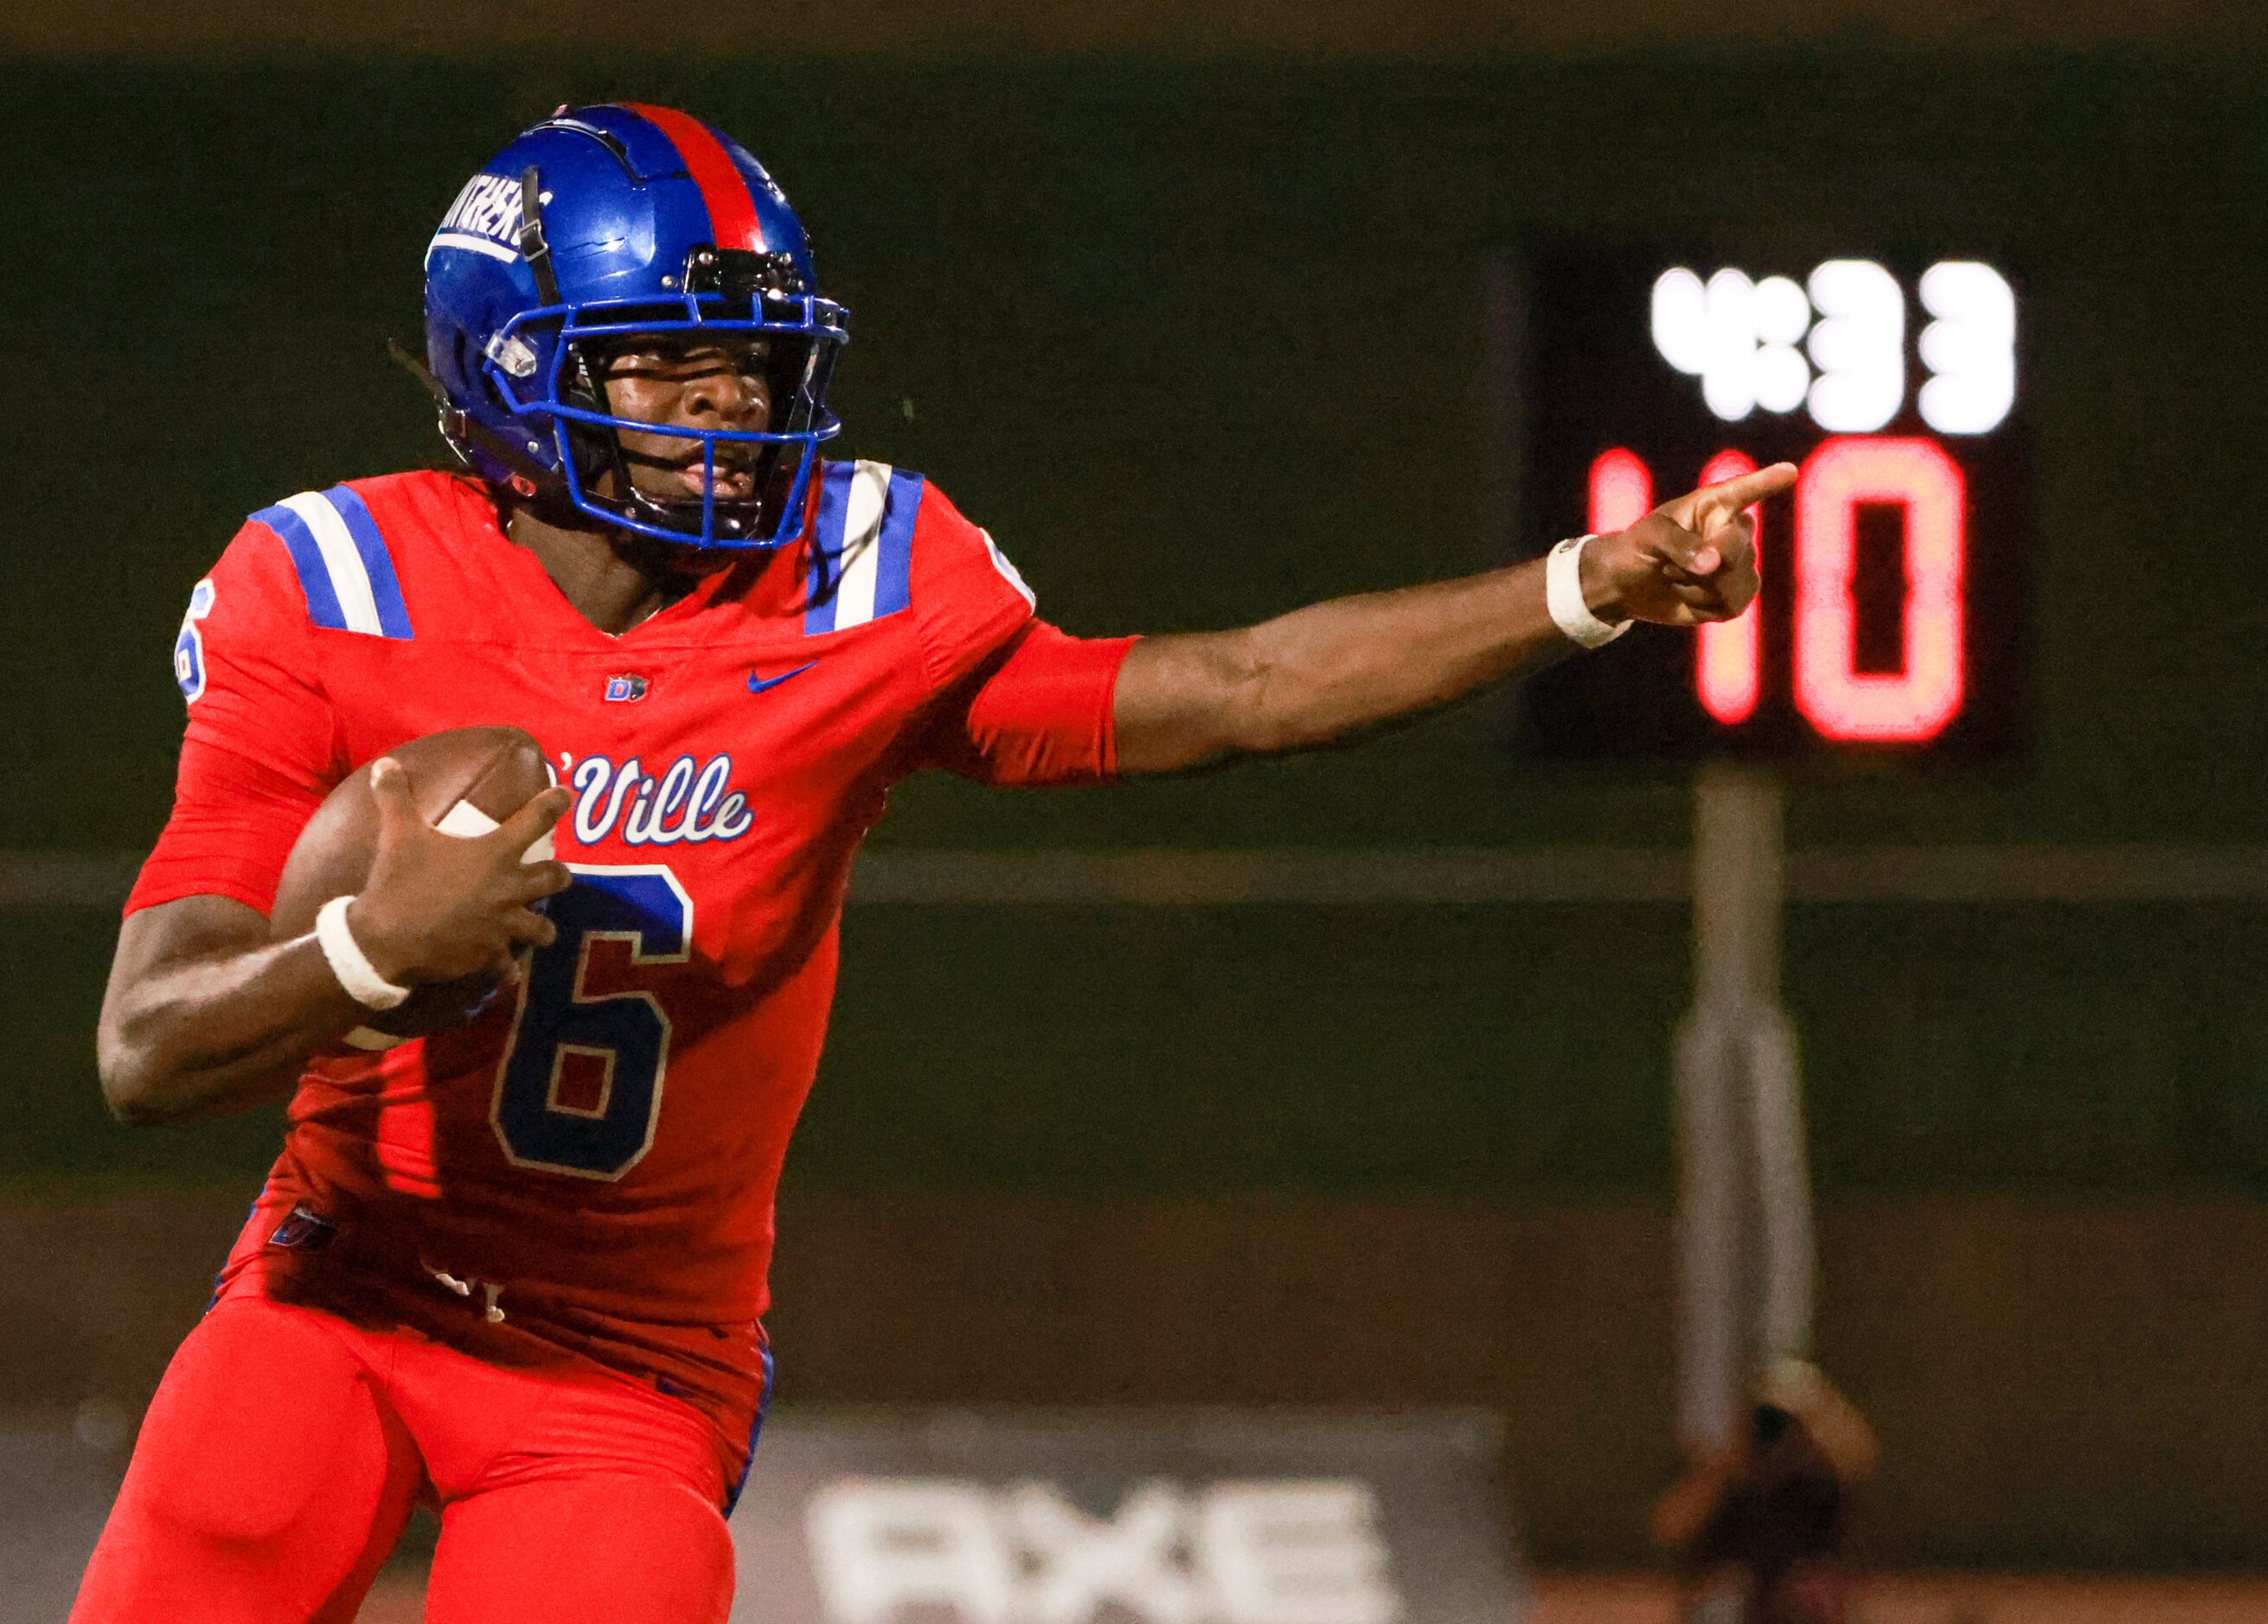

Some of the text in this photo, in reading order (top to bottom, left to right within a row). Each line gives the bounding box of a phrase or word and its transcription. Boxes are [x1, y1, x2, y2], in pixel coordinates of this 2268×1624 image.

[1651, 260, 2015, 434] 4:33
[545, 751, 754, 847] 'Ville
[489, 862, 694, 1182] 6
[808, 1479, 1399, 1624] AXE
